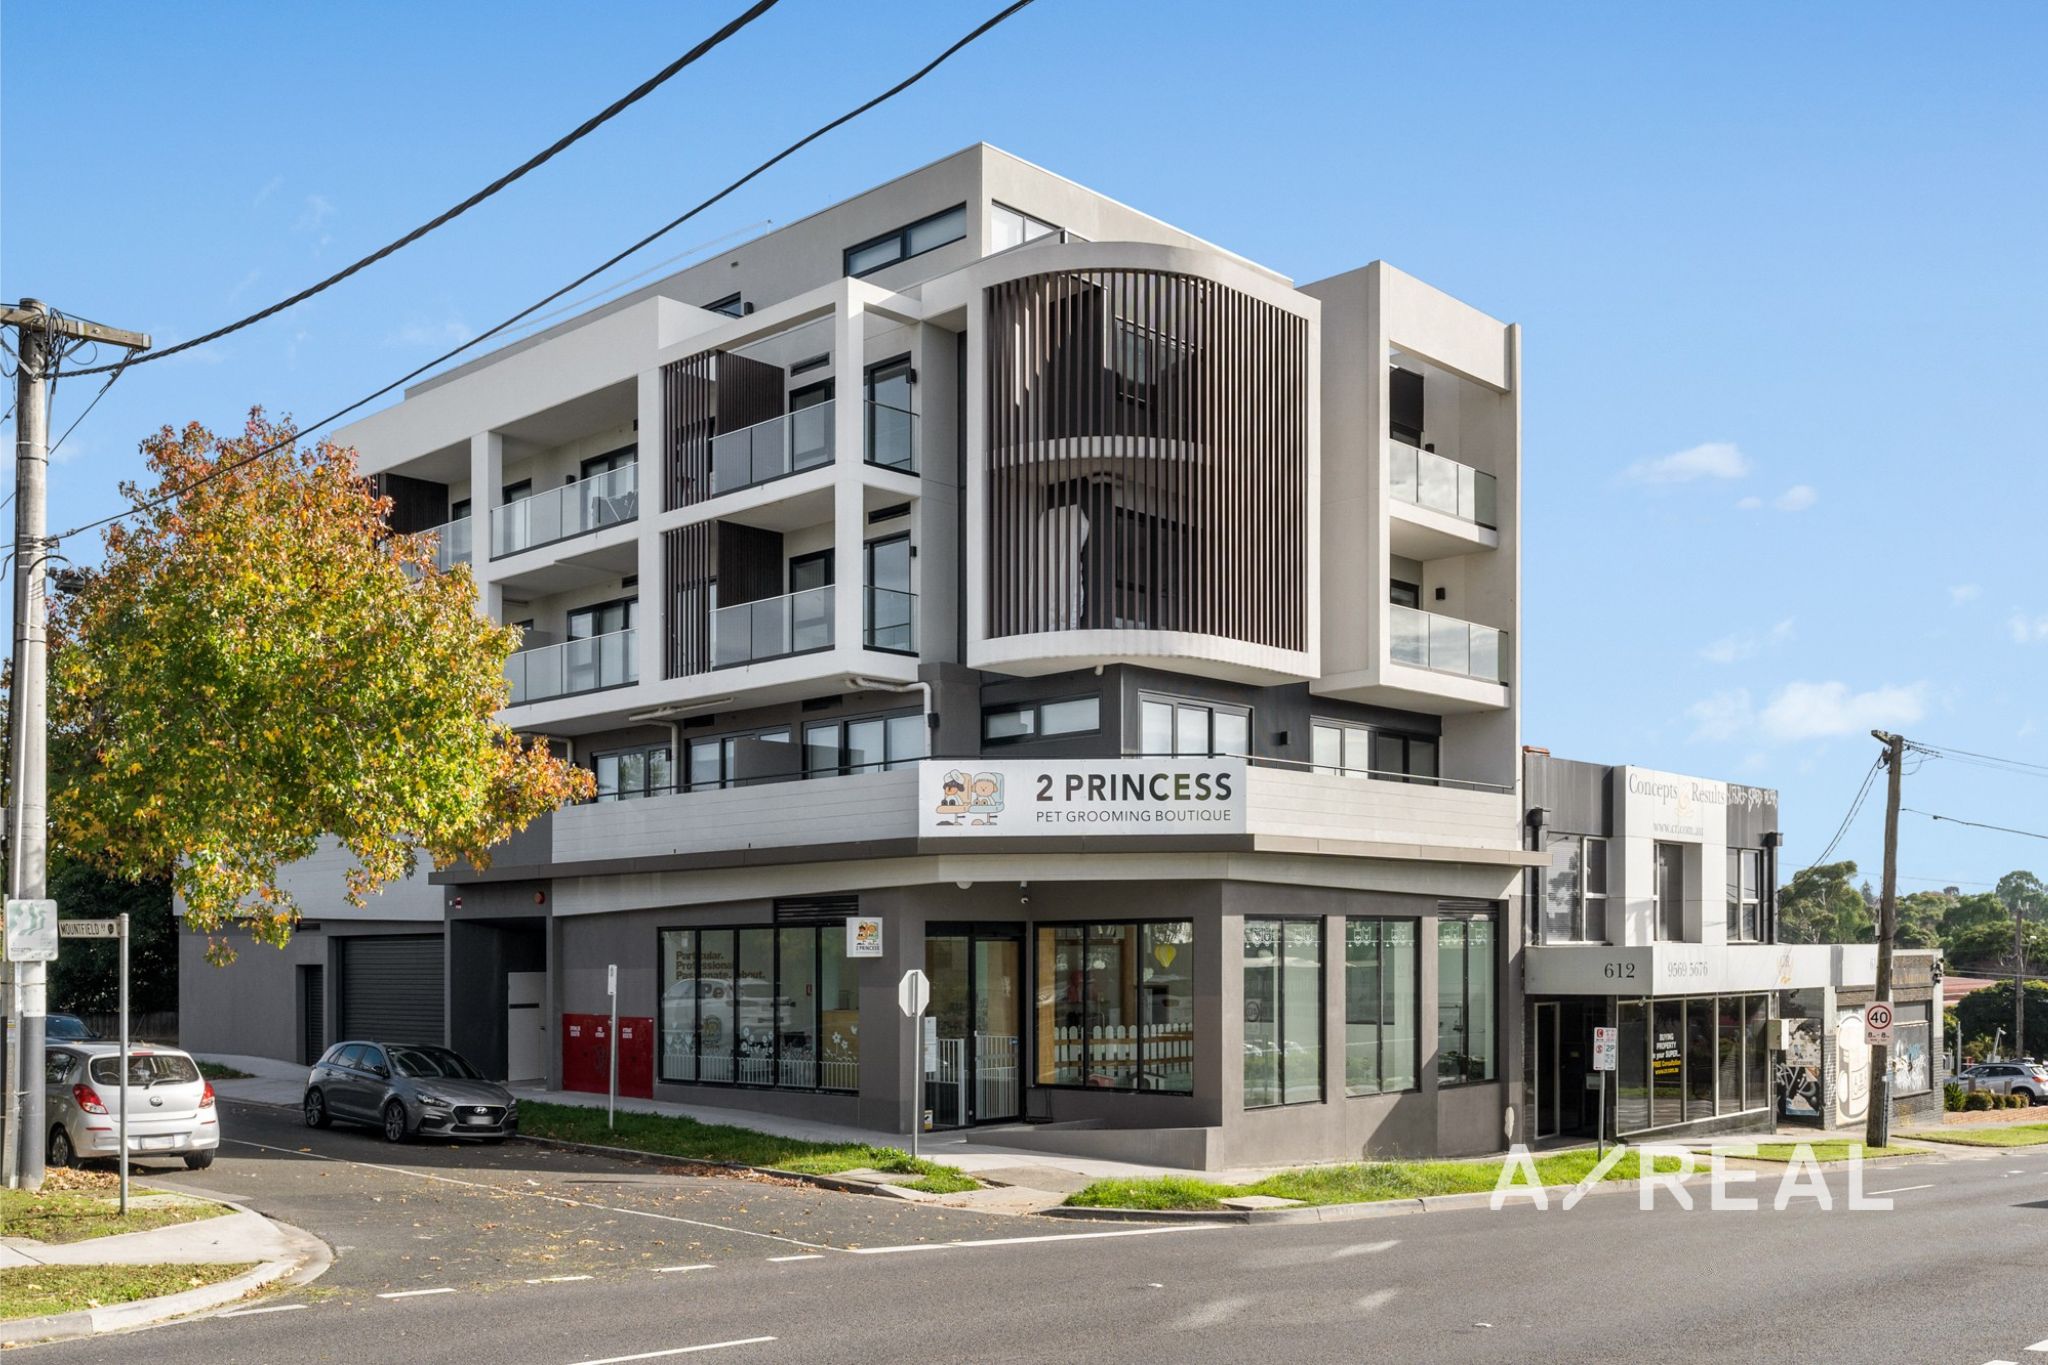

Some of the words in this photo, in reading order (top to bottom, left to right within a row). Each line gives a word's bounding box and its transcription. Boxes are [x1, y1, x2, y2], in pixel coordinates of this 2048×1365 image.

[1036, 774, 1053, 801] 2
[1066, 773, 1232, 801] PRINCESS
[1629, 773, 1678, 805] Concepts
[1691, 782, 1725, 805] Results
[1036, 811, 1062, 823] PET
[1066, 810, 1151, 822] GROOMING
[1155, 809, 1231, 821] BOUTIQUE
[60, 923, 100, 935] MOUNTFIELD
[1604, 962, 1635, 979] 612
[1667, 961, 1687, 977] 9569
[1689, 961, 1708, 977] 5676
[1870, 1011, 1888, 1024] 40
[1659, 1033, 1674, 1041] BUYING
[1606, 1044, 1614, 1052] 2P
[1656, 1041, 1677, 1050] PROPERTY
